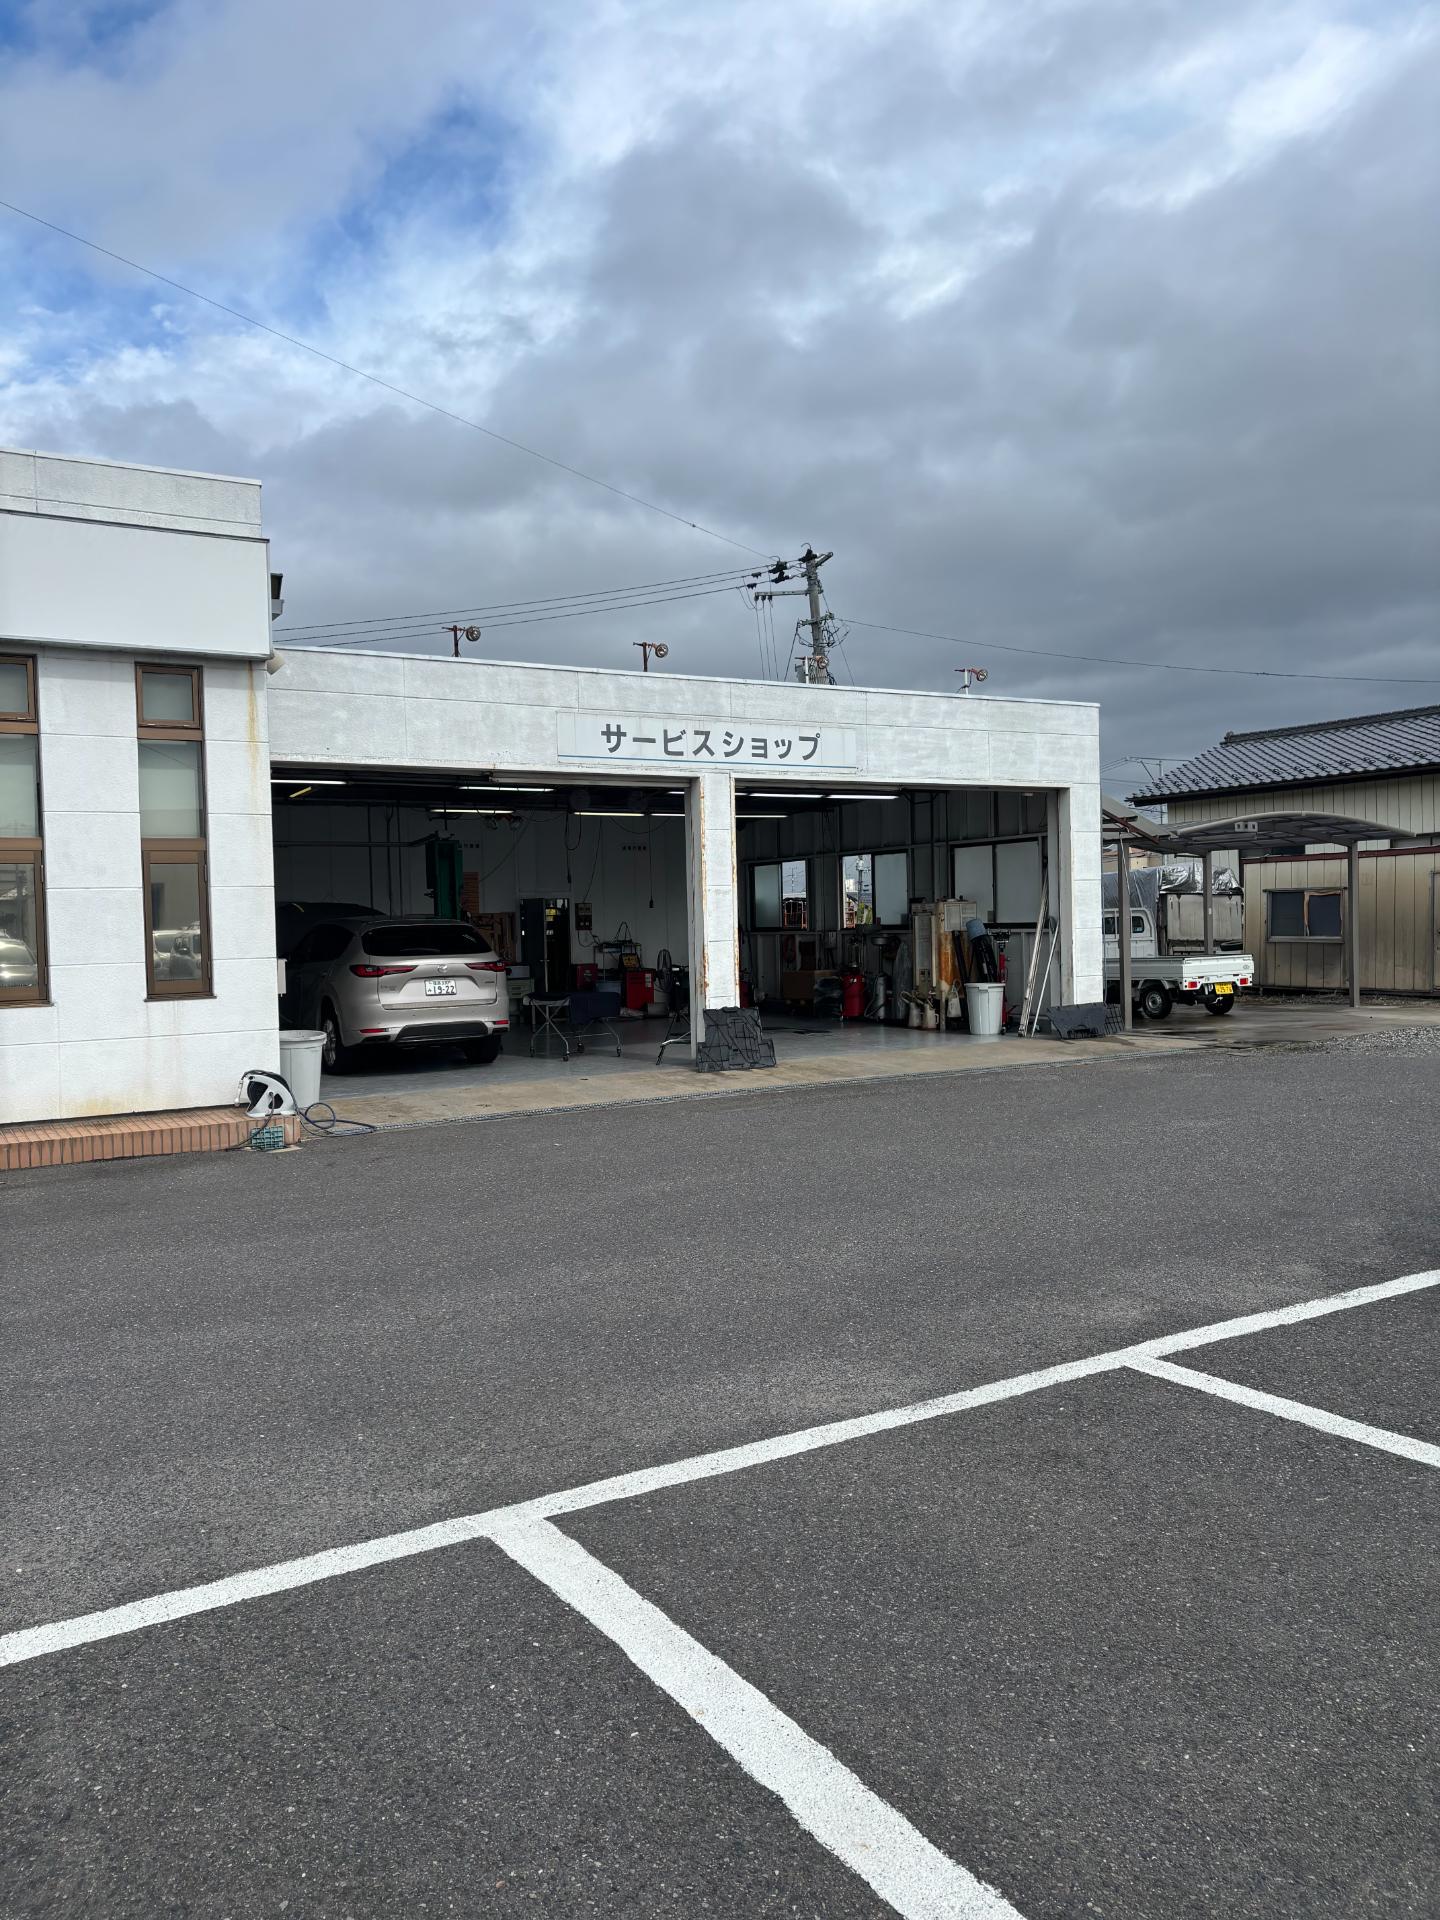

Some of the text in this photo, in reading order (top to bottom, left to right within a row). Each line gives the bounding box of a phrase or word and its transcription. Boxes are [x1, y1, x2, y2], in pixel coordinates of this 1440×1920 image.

[600, 723, 821, 760] サービスショップ
[433, 985, 455, 994] 19-22
